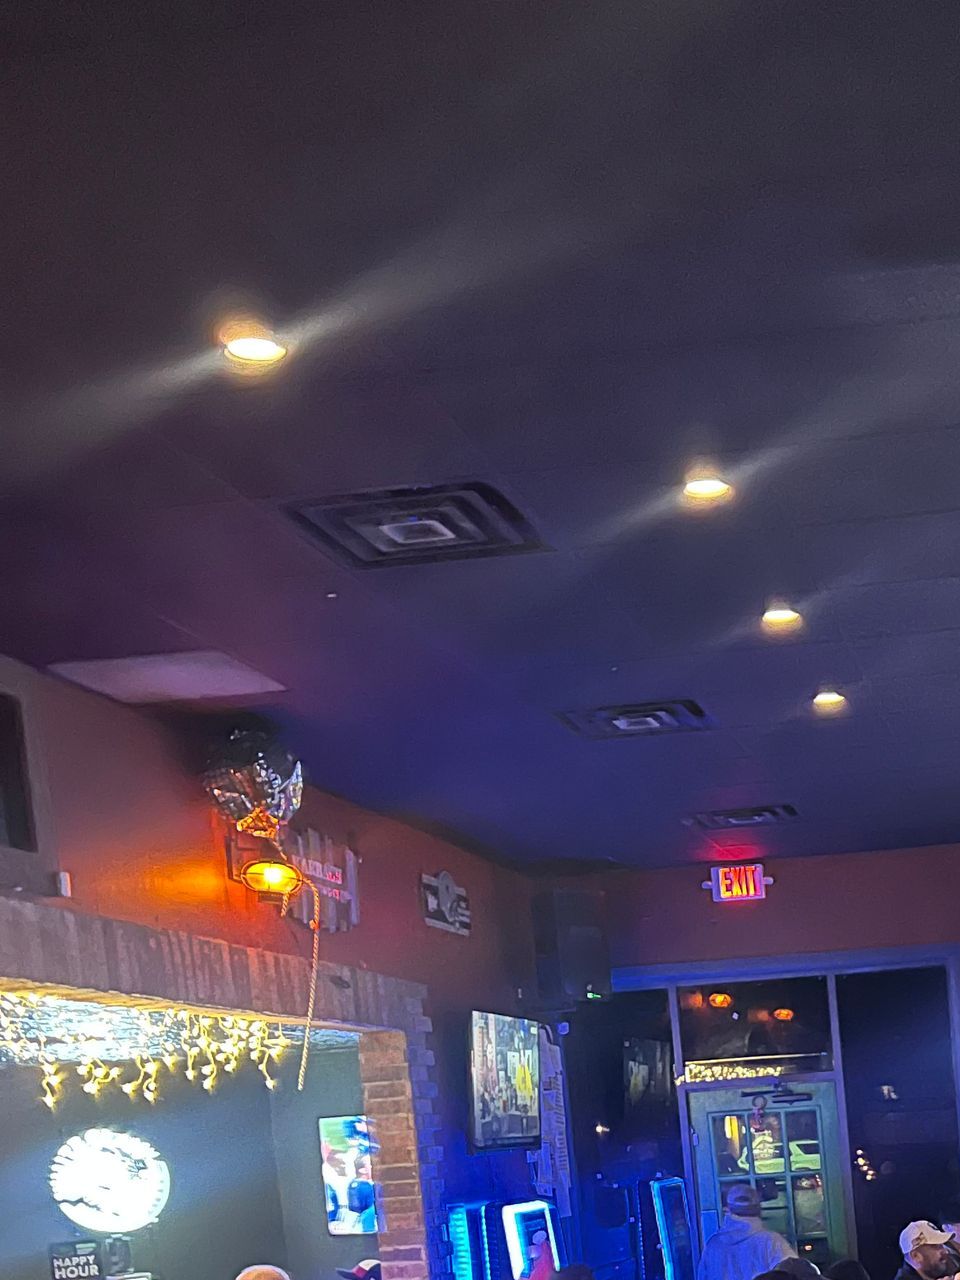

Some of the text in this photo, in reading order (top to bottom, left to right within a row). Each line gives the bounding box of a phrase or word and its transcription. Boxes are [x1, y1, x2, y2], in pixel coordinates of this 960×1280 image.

[719, 866, 755, 898] EXIT
[53, 1255, 95, 1269] HAPPY
[54, 1265, 100, 1280] HOUR
